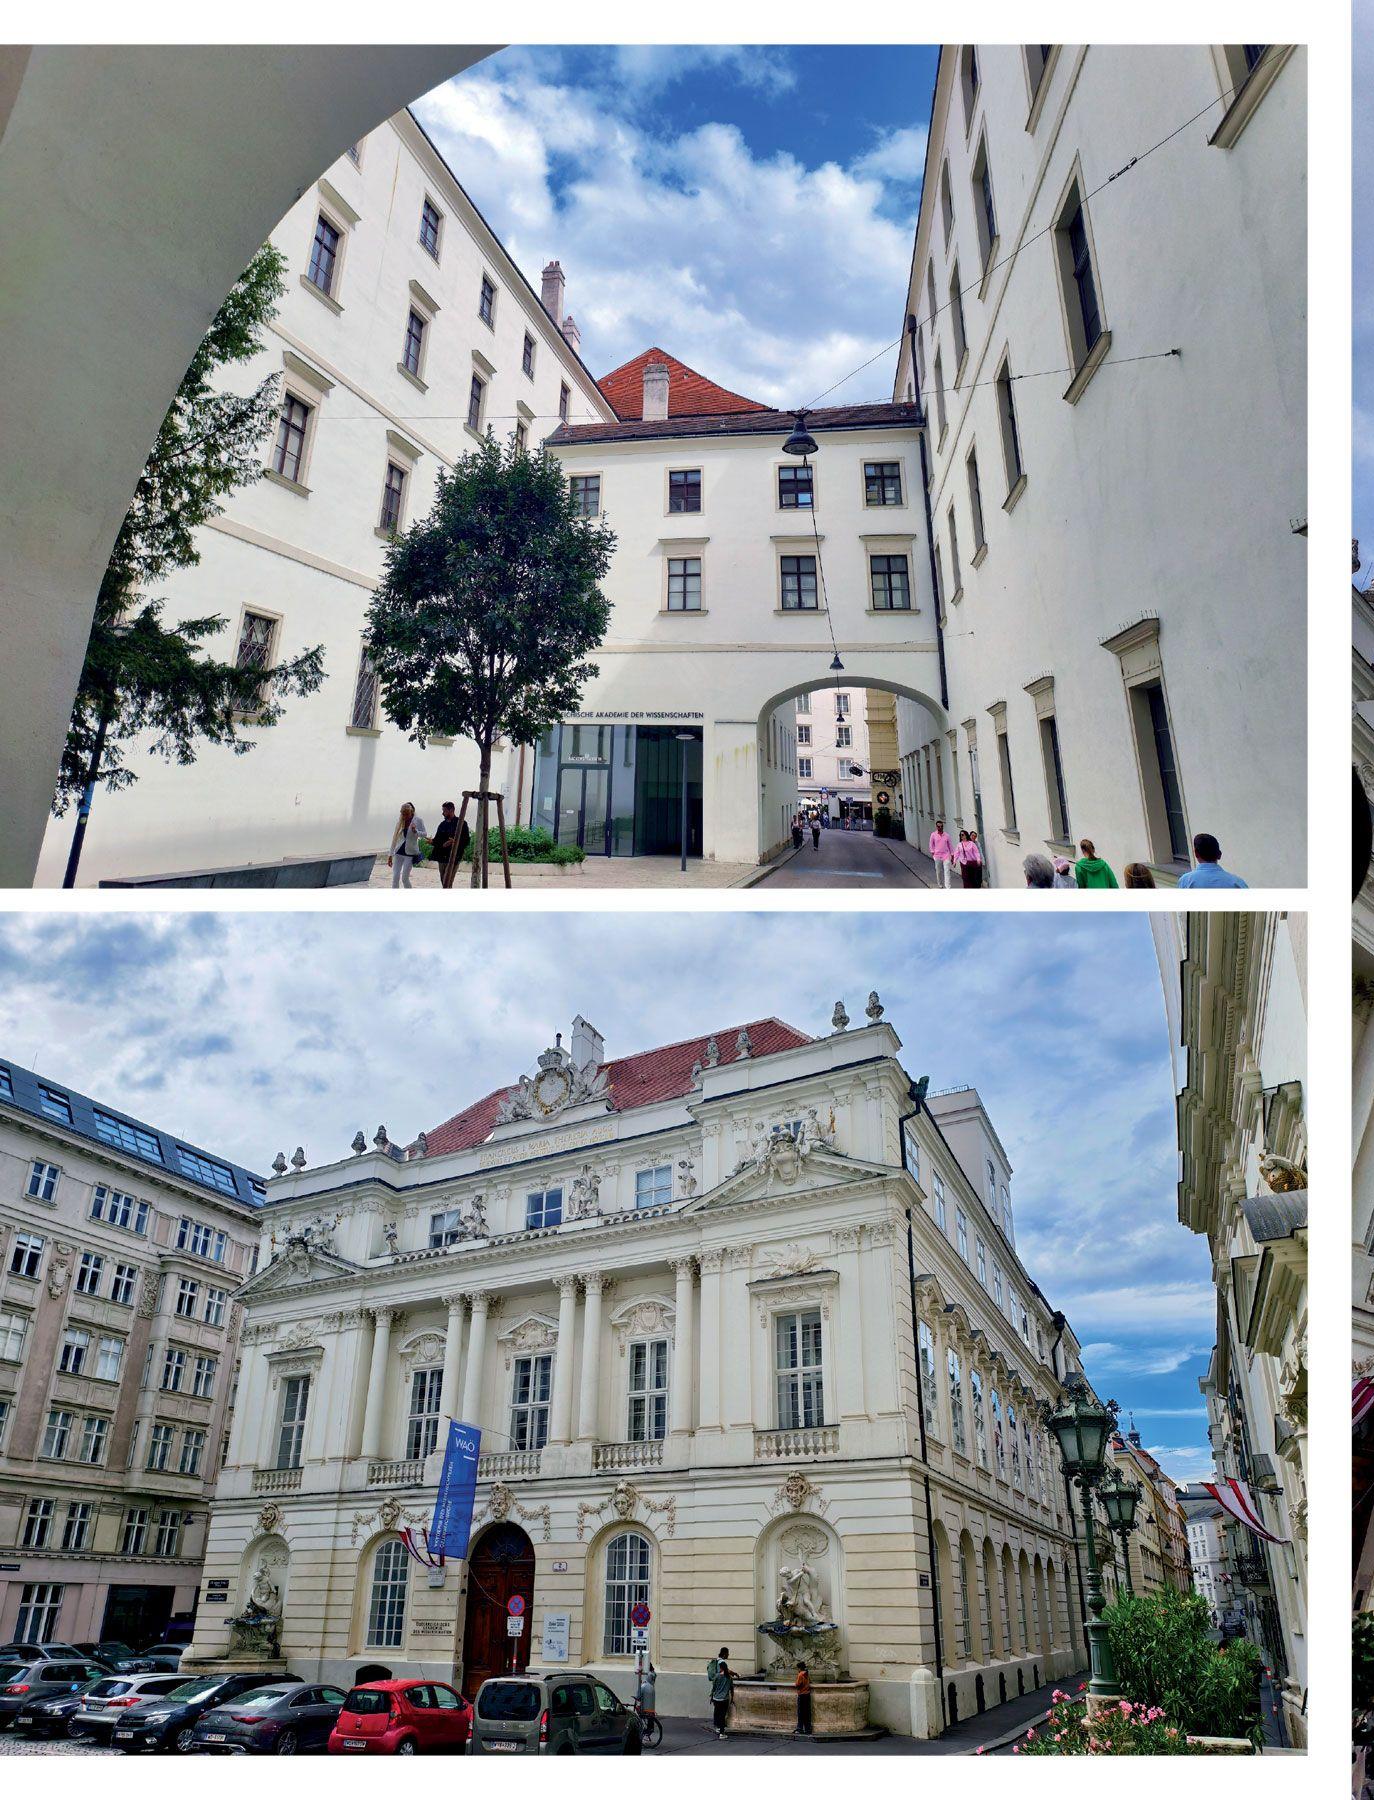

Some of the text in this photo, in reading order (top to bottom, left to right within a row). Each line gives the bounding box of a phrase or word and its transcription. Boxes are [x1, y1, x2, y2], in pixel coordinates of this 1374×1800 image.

[595, 711, 629, 719] AKADEMIE
[630, 711, 644, 719] DER
[645, 711, 704, 719] WISSENSCHAFTEN
